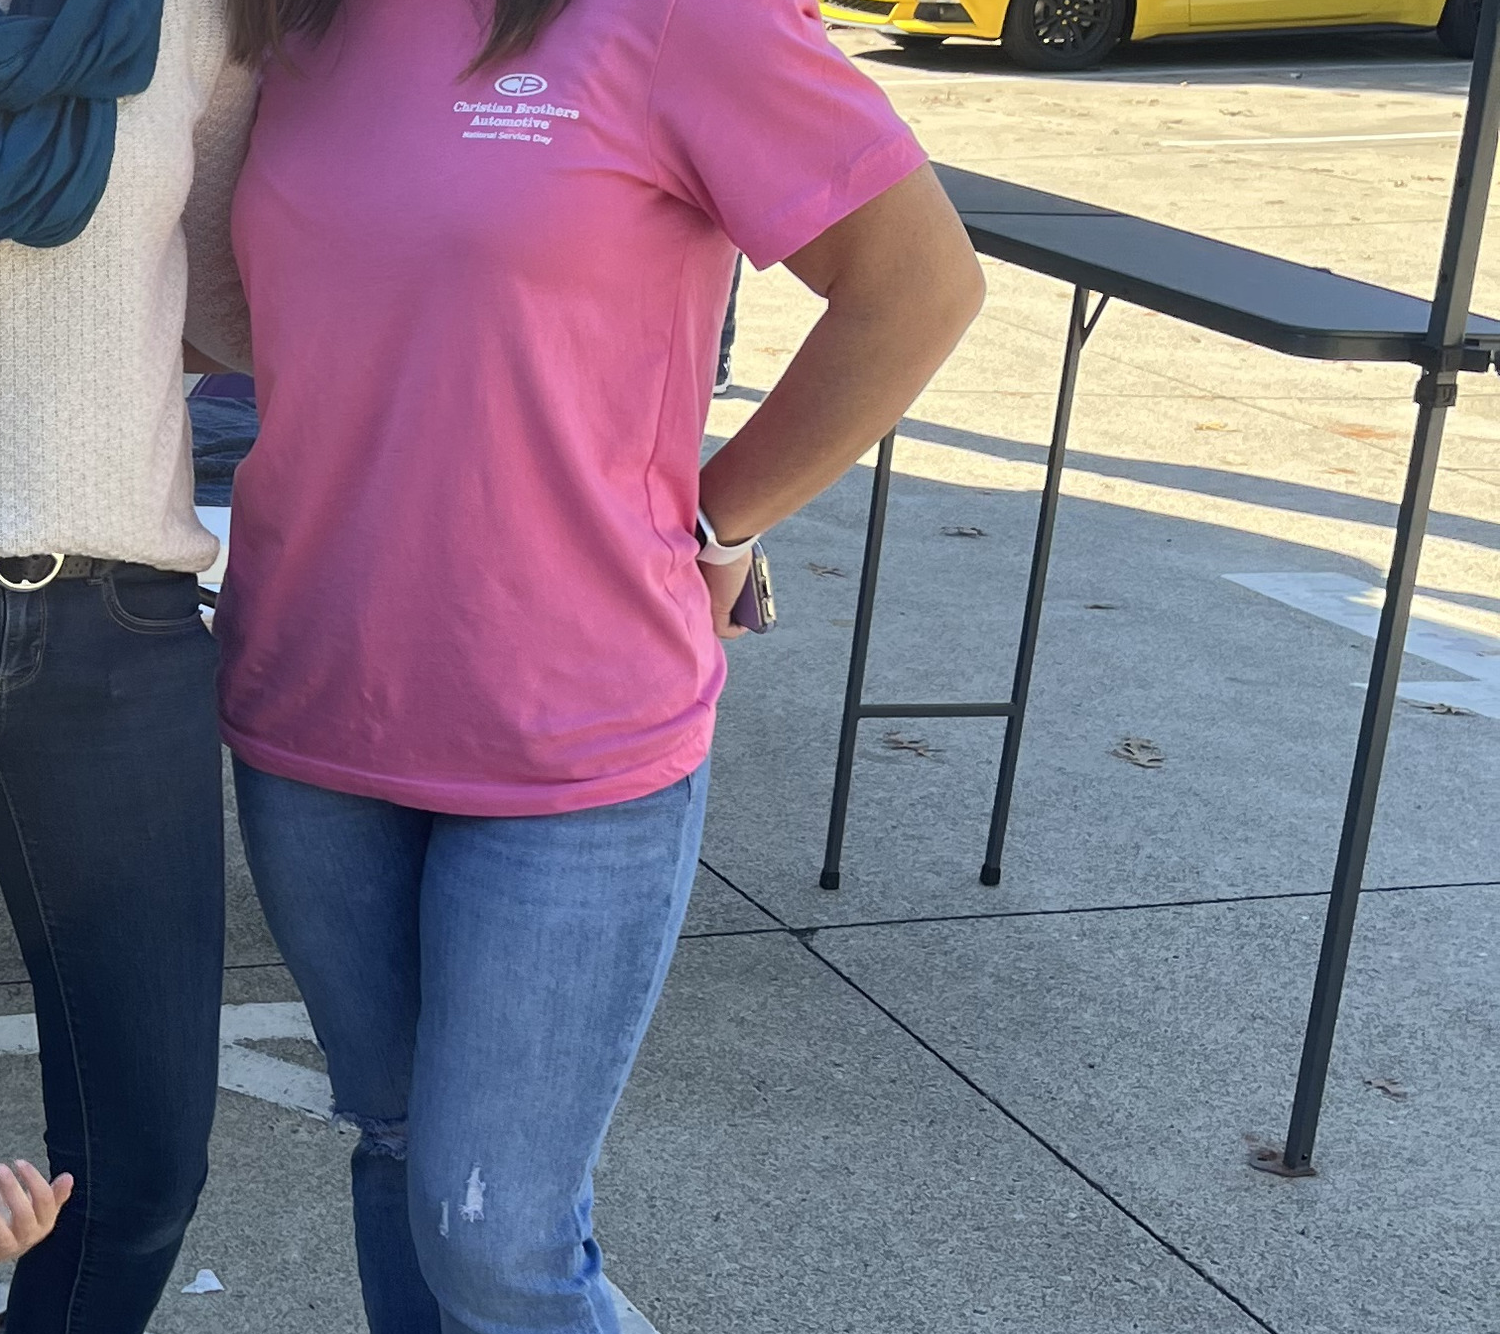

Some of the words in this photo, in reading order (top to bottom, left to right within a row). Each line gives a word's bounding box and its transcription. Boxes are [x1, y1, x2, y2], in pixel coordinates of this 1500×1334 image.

[453, 101, 513, 113] Christian
[515, 103, 580, 119] Brothers
[470, 115, 551, 129] Automotive
[498, 131, 531, 141] Service
[533, 133, 553, 145] Day
